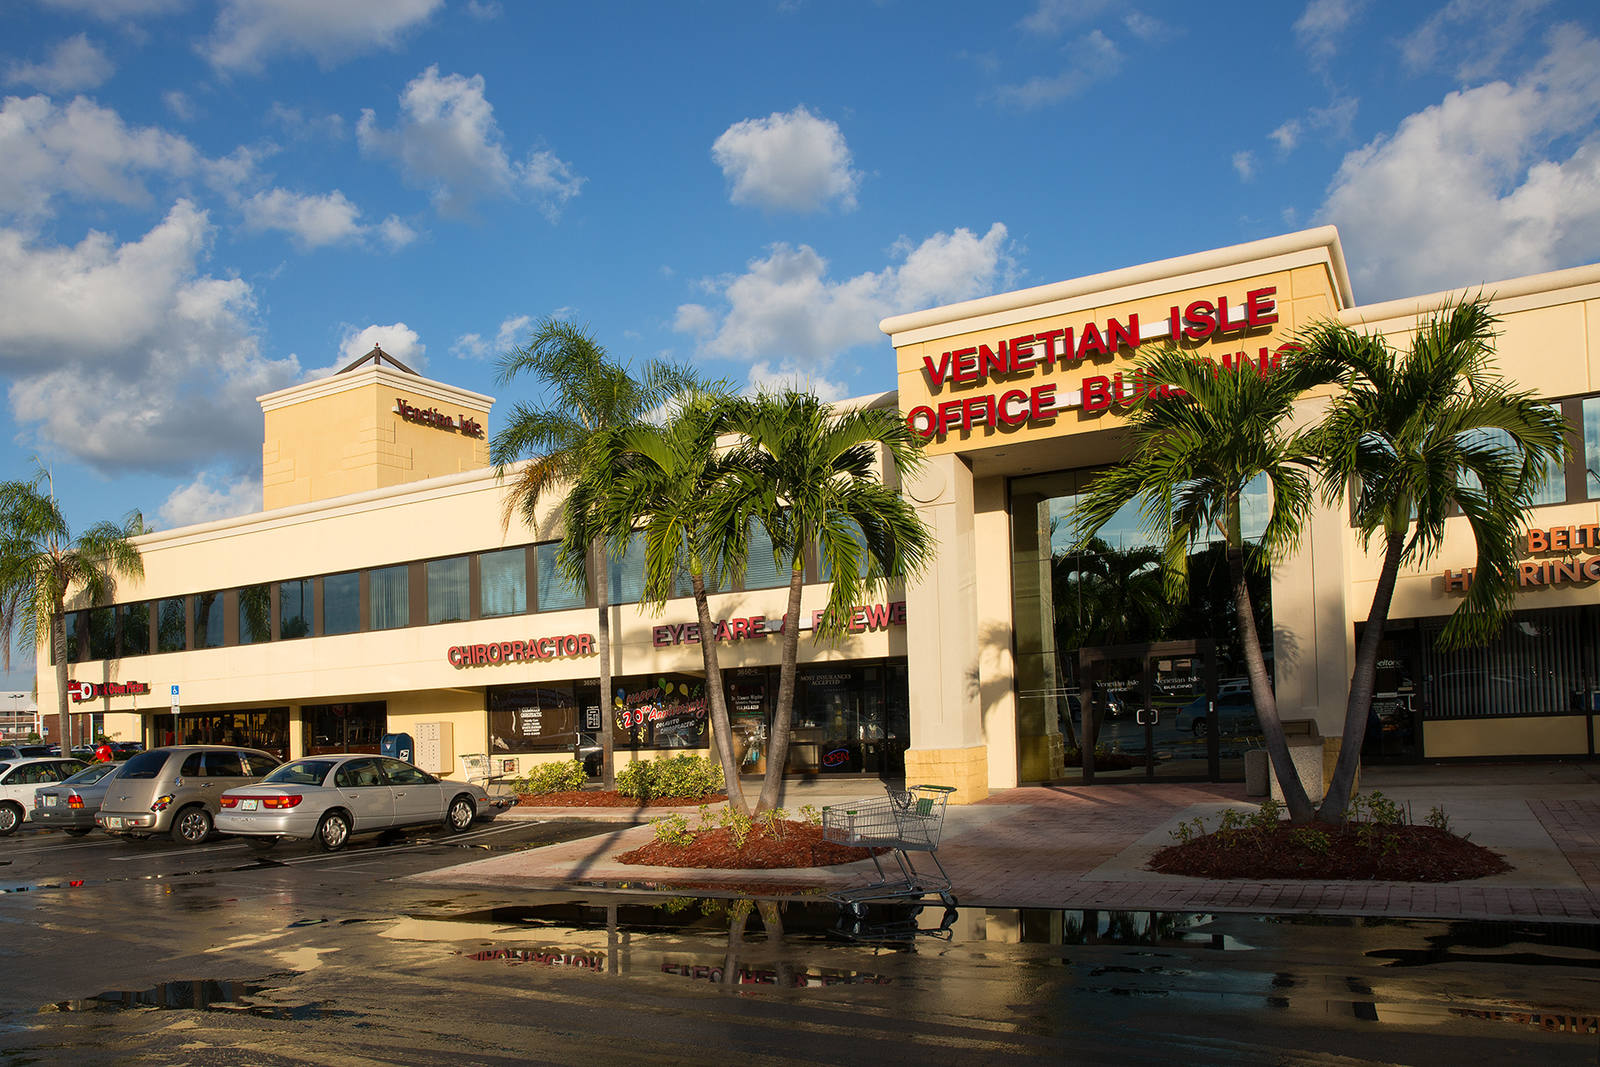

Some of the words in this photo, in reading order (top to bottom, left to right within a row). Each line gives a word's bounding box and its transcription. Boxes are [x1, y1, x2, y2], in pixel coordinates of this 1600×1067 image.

[923, 313, 1140, 387] VENETIAN
[1169, 286, 1279, 342] ISLE
[396, 398, 454, 426] Venetian
[458, 414, 485, 435] Isle
[907, 383, 1058, 438] OFFICE
[1528, 523, 1600, 553] BELT
[1444, 557, 1600, 594] HRING
[653, 616, 766, 648] EYEARE
[812, 601, 906, 634] EEWE
[447, 633, 594, 667] CHIROPRACTOR
[1377, 659, 1401, 667] eltone
[109, 683, 126, 695] Oven
[127, 680, 144, 693] Pizza
[625, 687, 660, 705] HAPPY
[823, 752, 849, 764] OPEN
